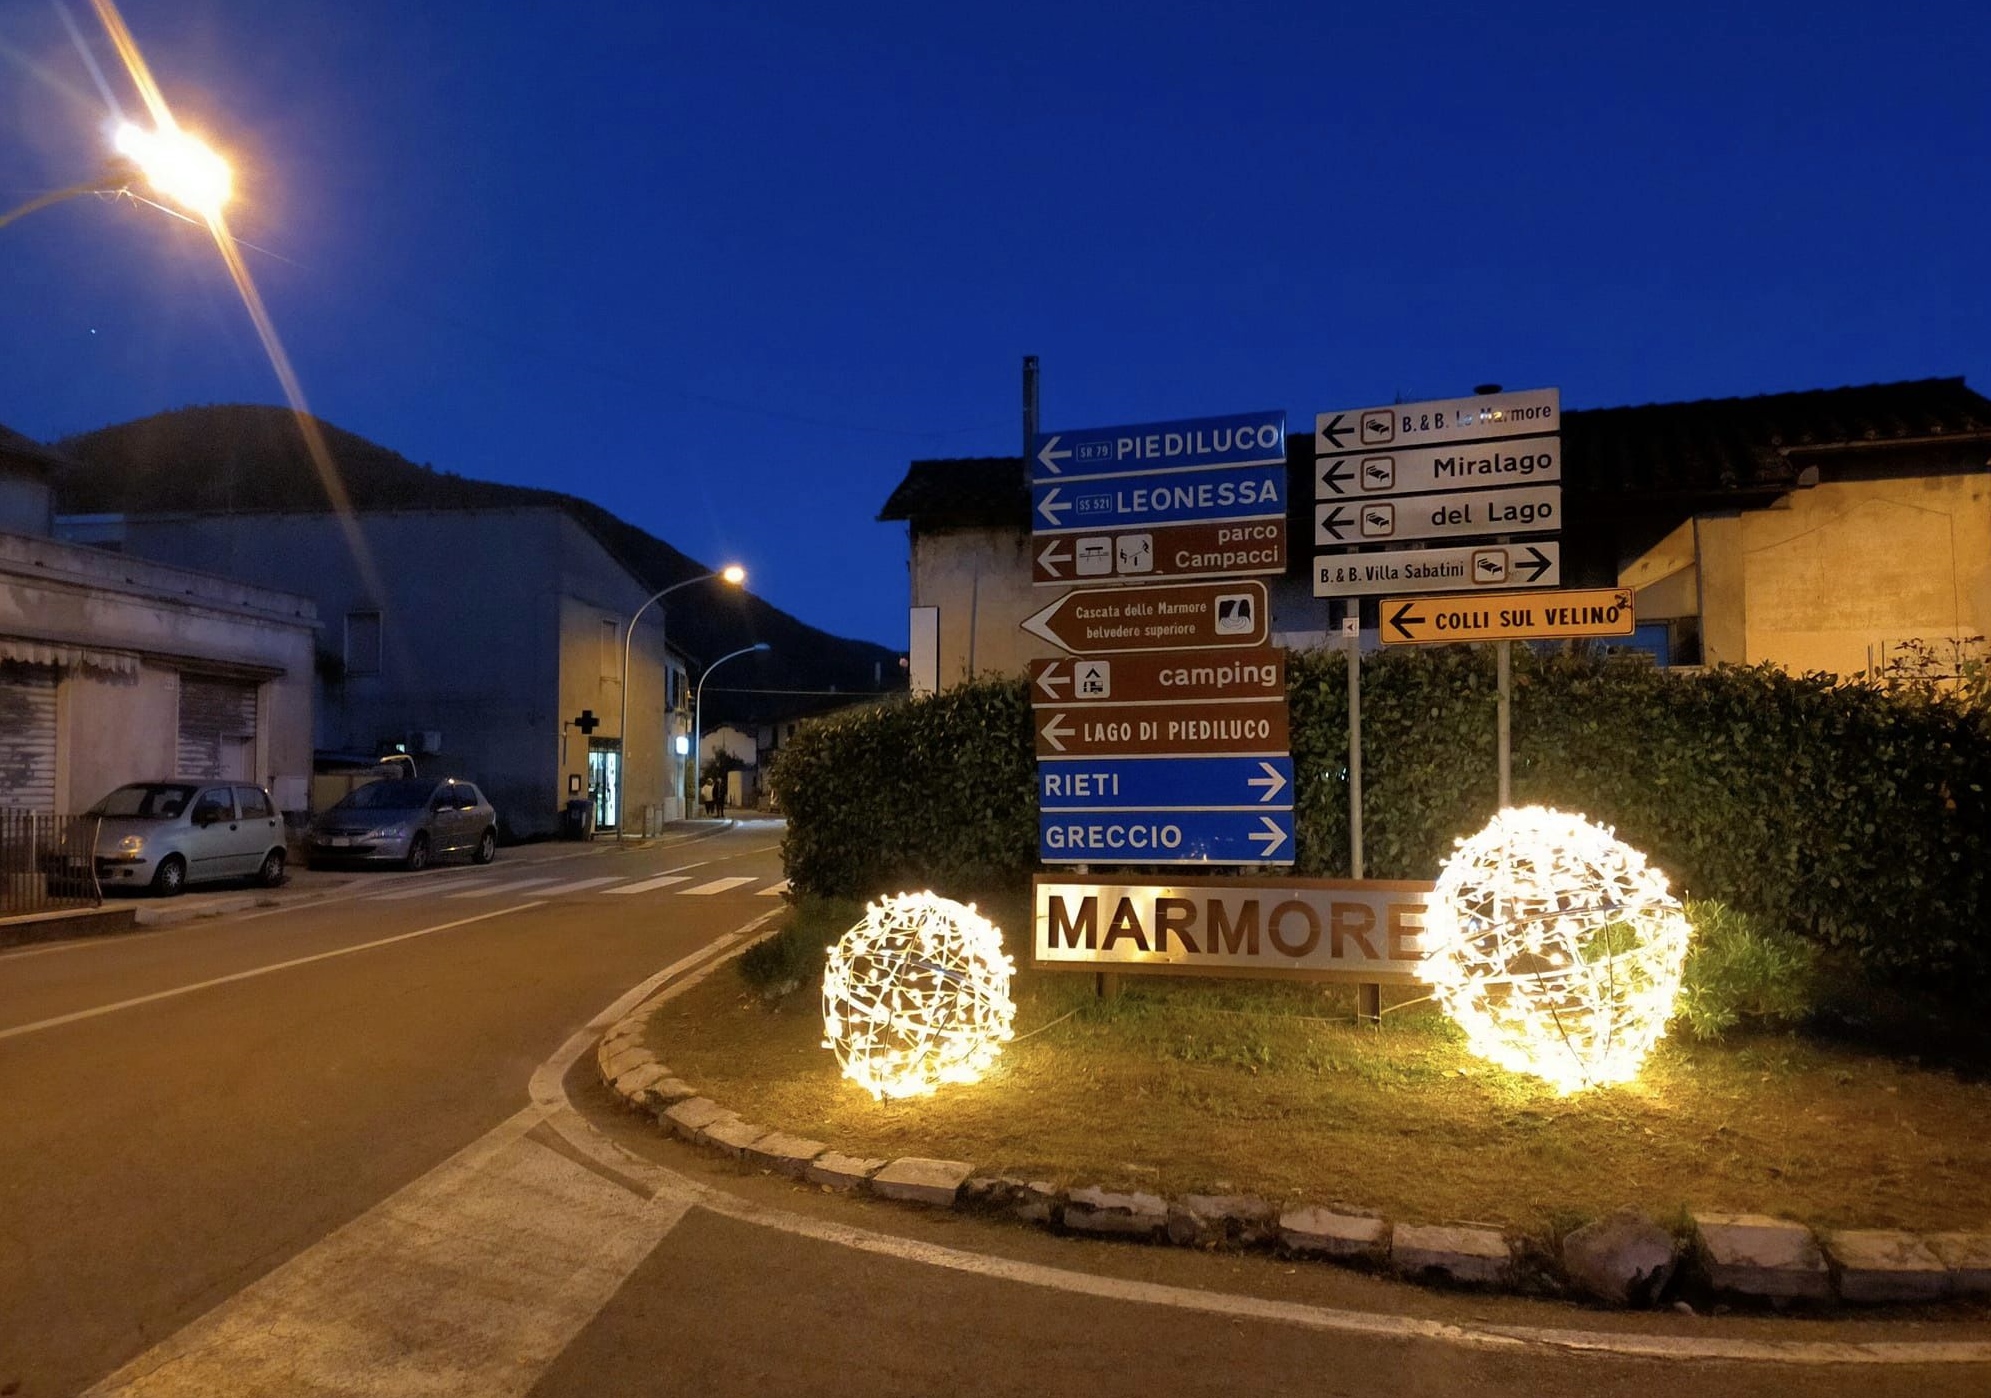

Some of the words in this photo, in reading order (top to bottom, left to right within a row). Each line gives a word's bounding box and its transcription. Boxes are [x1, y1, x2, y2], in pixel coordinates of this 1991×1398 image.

[1080, 446, 1093, 459] SR
[1096, 445, 1109, 457] 79
[1117, 424, 1278, 461] PIEDILUCO
[1434, 453, 1552, 478] Miralago
[1079, 499, 1091, 511] SS
[1093, 497, 1110, 510] 521
[1117, 479, 1278, 513] LEONESSA
[1431, 504, 1472, 526] del
[1488, 502, 1552, 524] Lago
[1218, 525, 1278, 546] parco
[1175, 546, 1278, 568] Campacci
[1365, 564, 1399, 581] Villa
[1404, 562, 1464, 579] Sabatini
[1076, 604, 1120, 619] Cascata
[1124, 602, 1153, 617] delle
[1158, 601, 1207, 615] Marmore
[1435, 611, 1489, 630] COLLI
[1500, 609, 1535, 627] SUL
[1545, 606, 1619, 625] VELINO
[1086, 624, 1140, 639] belvedere
[1145, 622, 1196, 637] superiore
[1159, 662, 1277, 688] camping
[1084, 721, 1132, 742] LAGO
[1140, 721, 1158, 741] DI
[1169, 719, 1270, 740] PIEDILUCO
[1045, 773, 1119, 796] RIETI
[1046, 825, 1182, 849] GRECCIO
[1047, 894, 1429, 962] MARMORE
